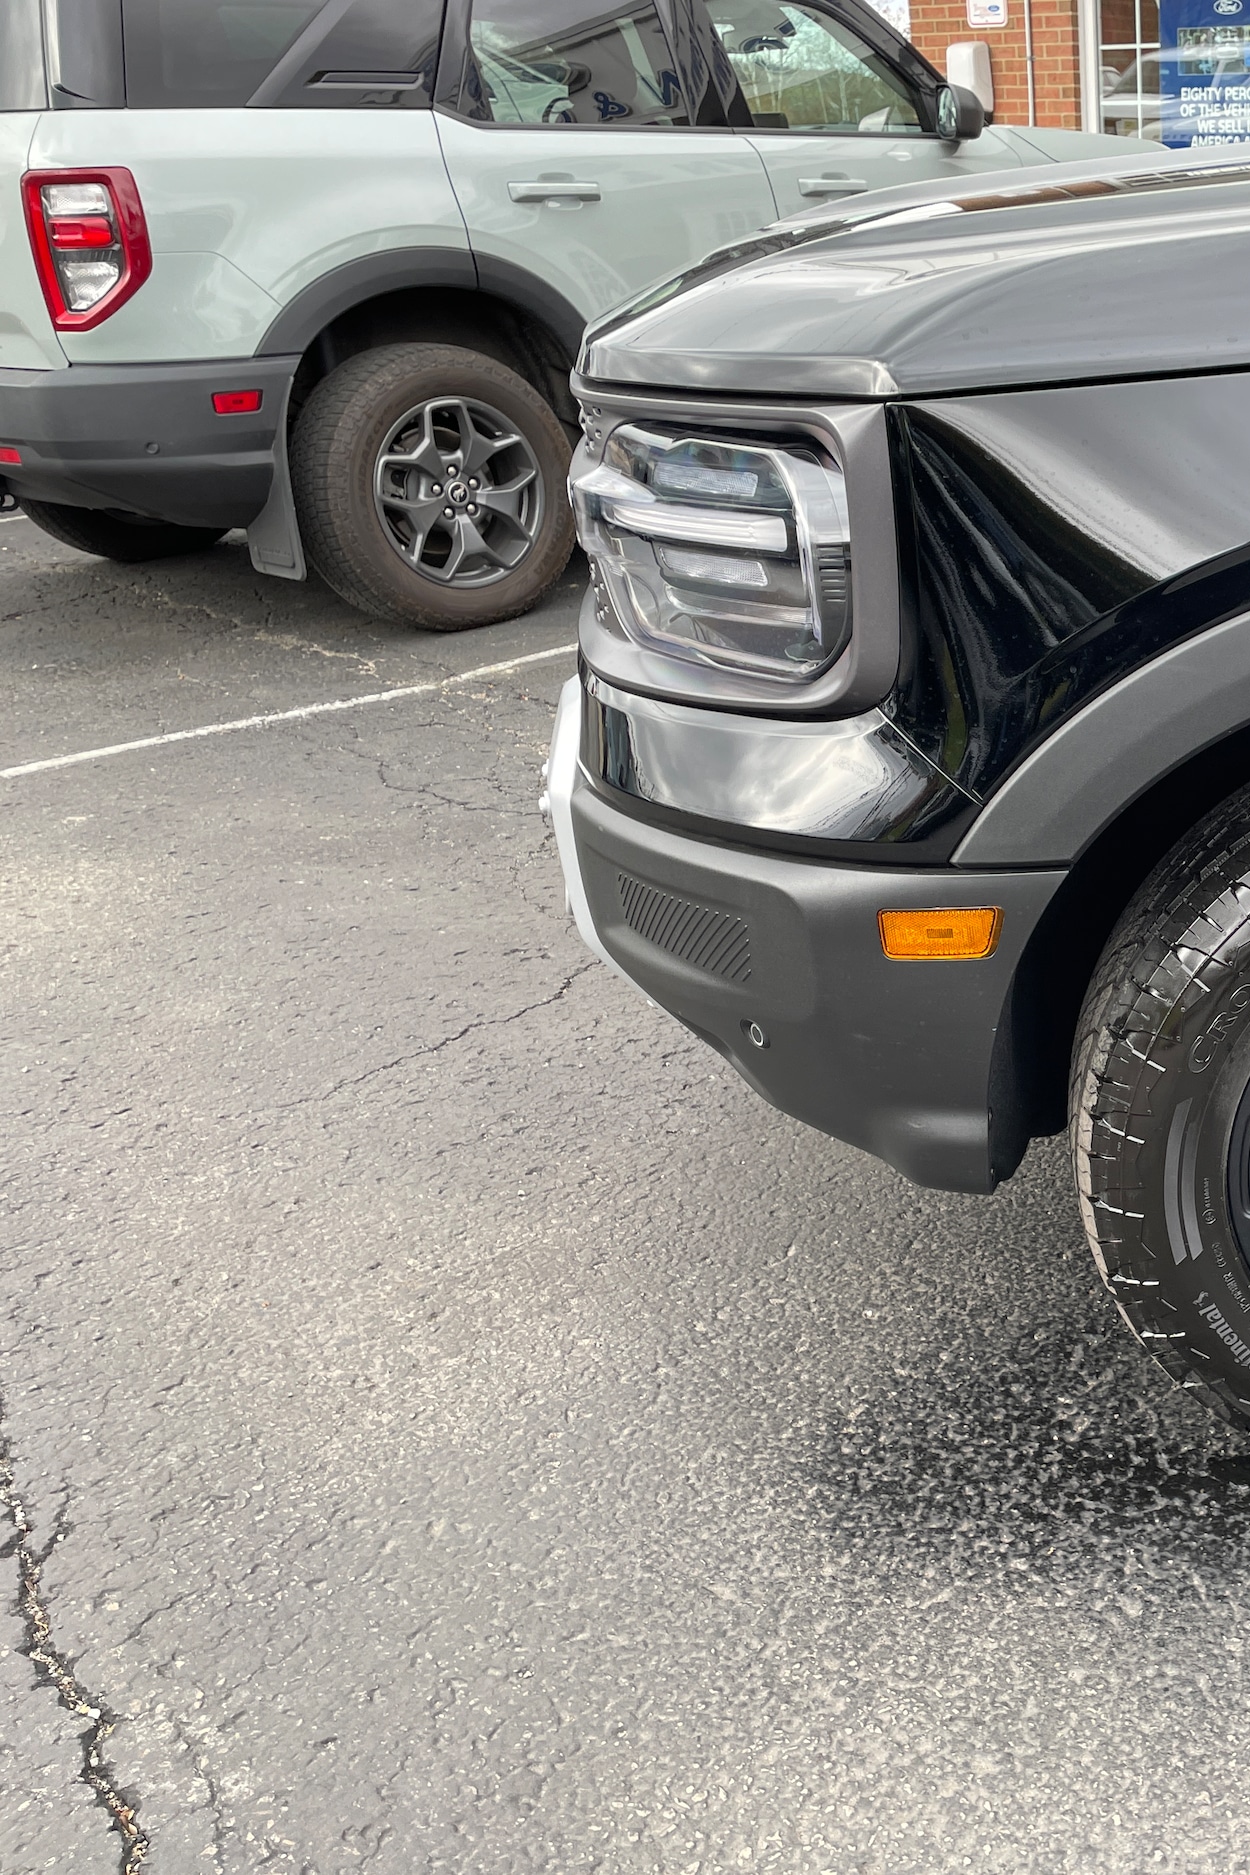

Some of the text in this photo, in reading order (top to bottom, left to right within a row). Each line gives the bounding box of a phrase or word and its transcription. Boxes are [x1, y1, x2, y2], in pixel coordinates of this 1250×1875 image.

[1180, 87, 1223, 102] EIGHTY
[1180, 104, 1196, 118] OF
[1200, 103, 1221, 117] THE
[1197, 119, 1216, 134] WE
[1218, 119, 1245, 134] SELL
[1190, 135, 1241, 149] AMERICA
